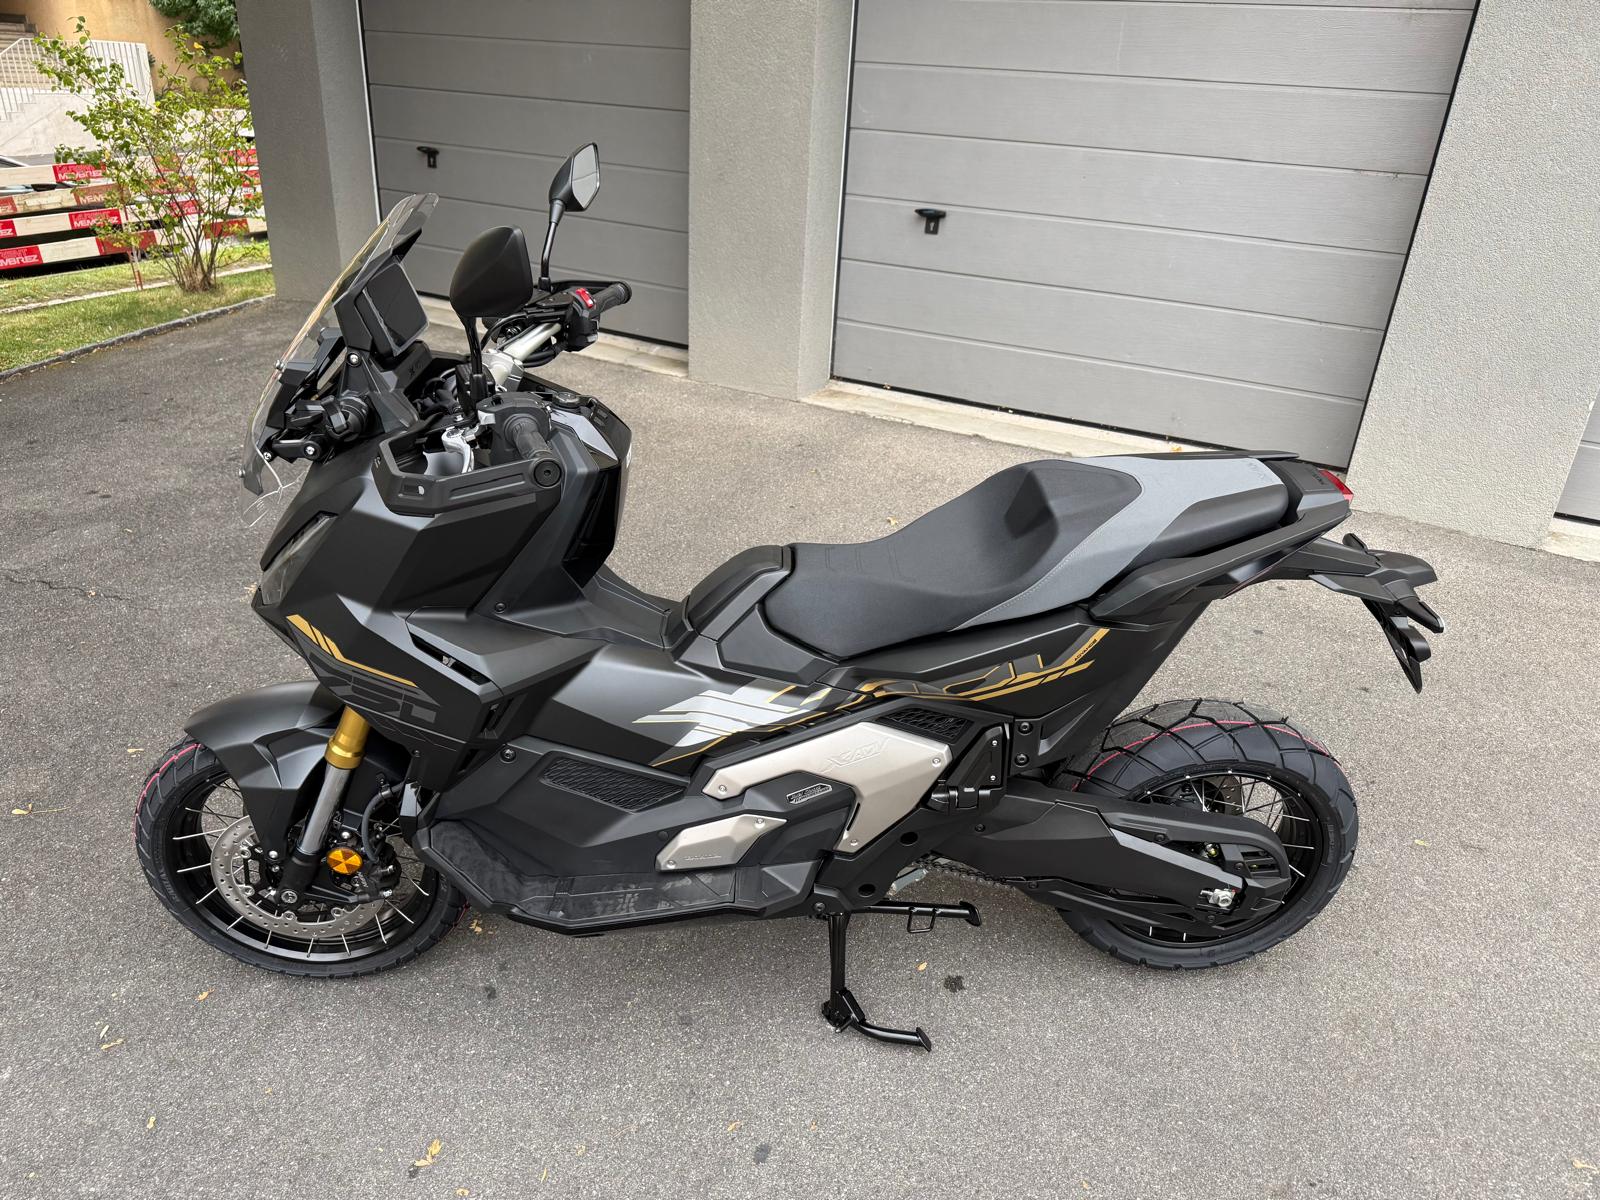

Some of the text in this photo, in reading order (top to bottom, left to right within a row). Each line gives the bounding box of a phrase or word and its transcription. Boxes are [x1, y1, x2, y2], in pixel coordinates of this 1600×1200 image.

[58, 169, 103, 180] MBREZ
[73, 216, 119, 228] MEMZ
[0, 254, 39, 267] MBREZ
